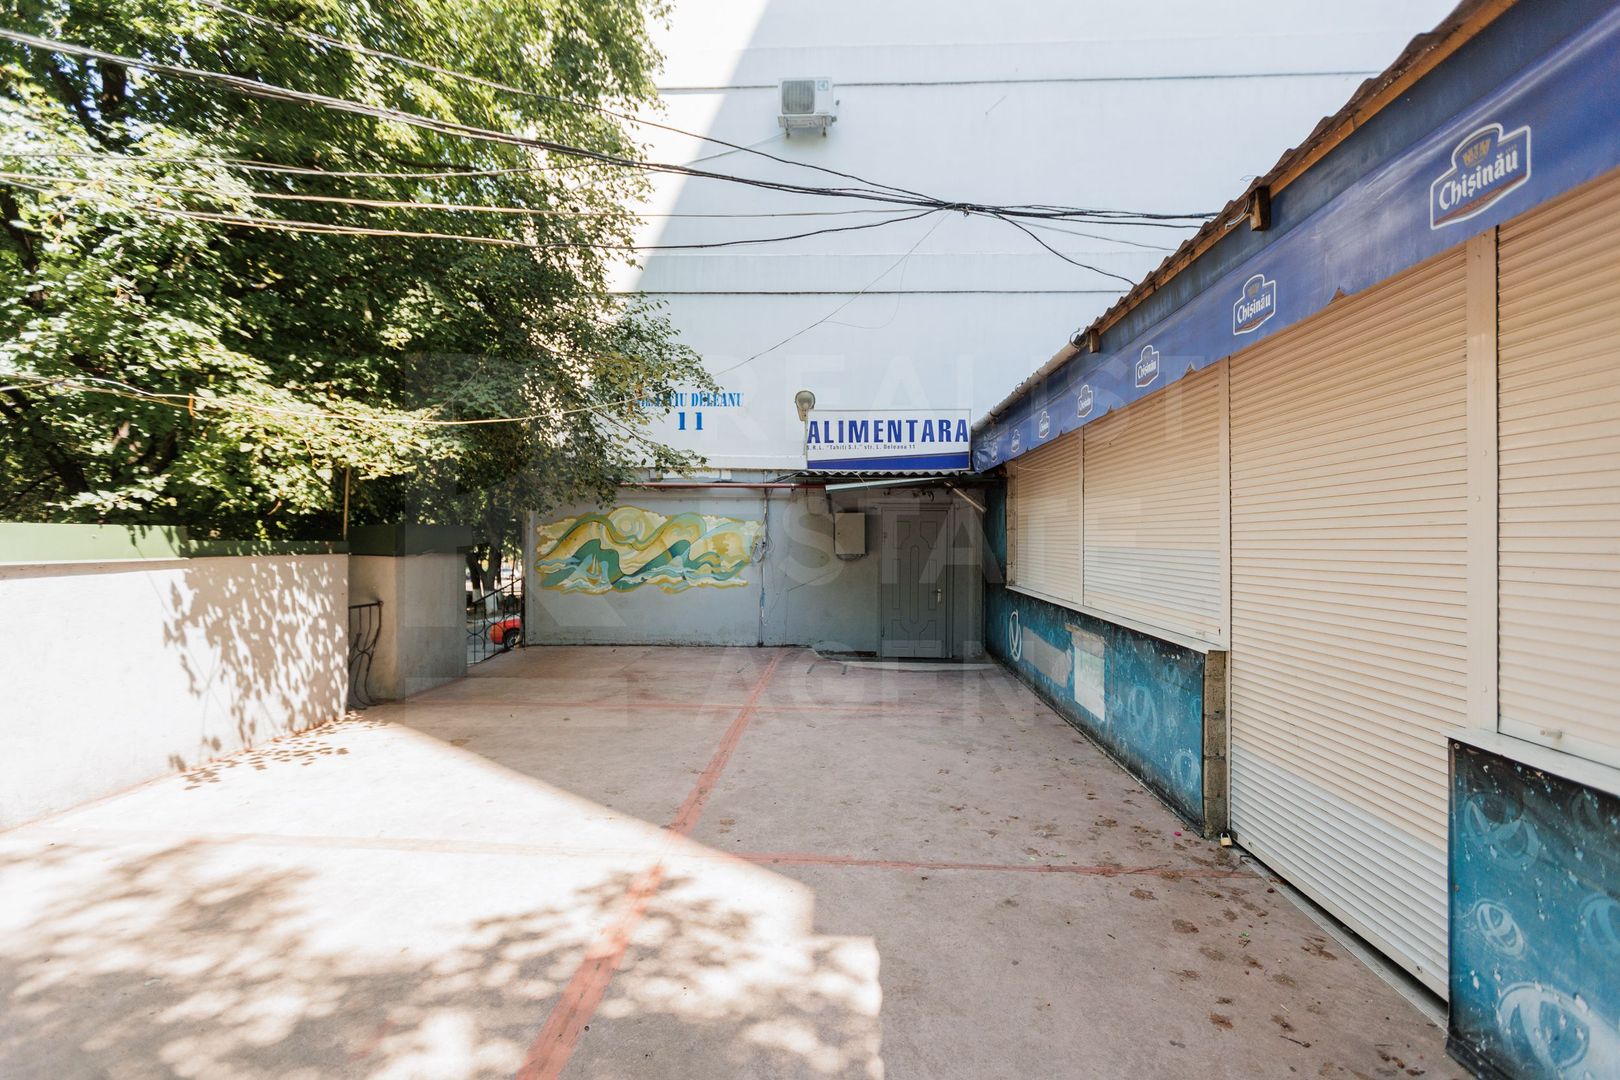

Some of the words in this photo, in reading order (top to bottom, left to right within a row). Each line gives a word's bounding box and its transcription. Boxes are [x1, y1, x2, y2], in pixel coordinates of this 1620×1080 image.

[1438, 150, 1519, 210] Chișinău
[691, 392, 744, 407] DELEANU
[807, 419, 969, 444] ALIMENTARA
